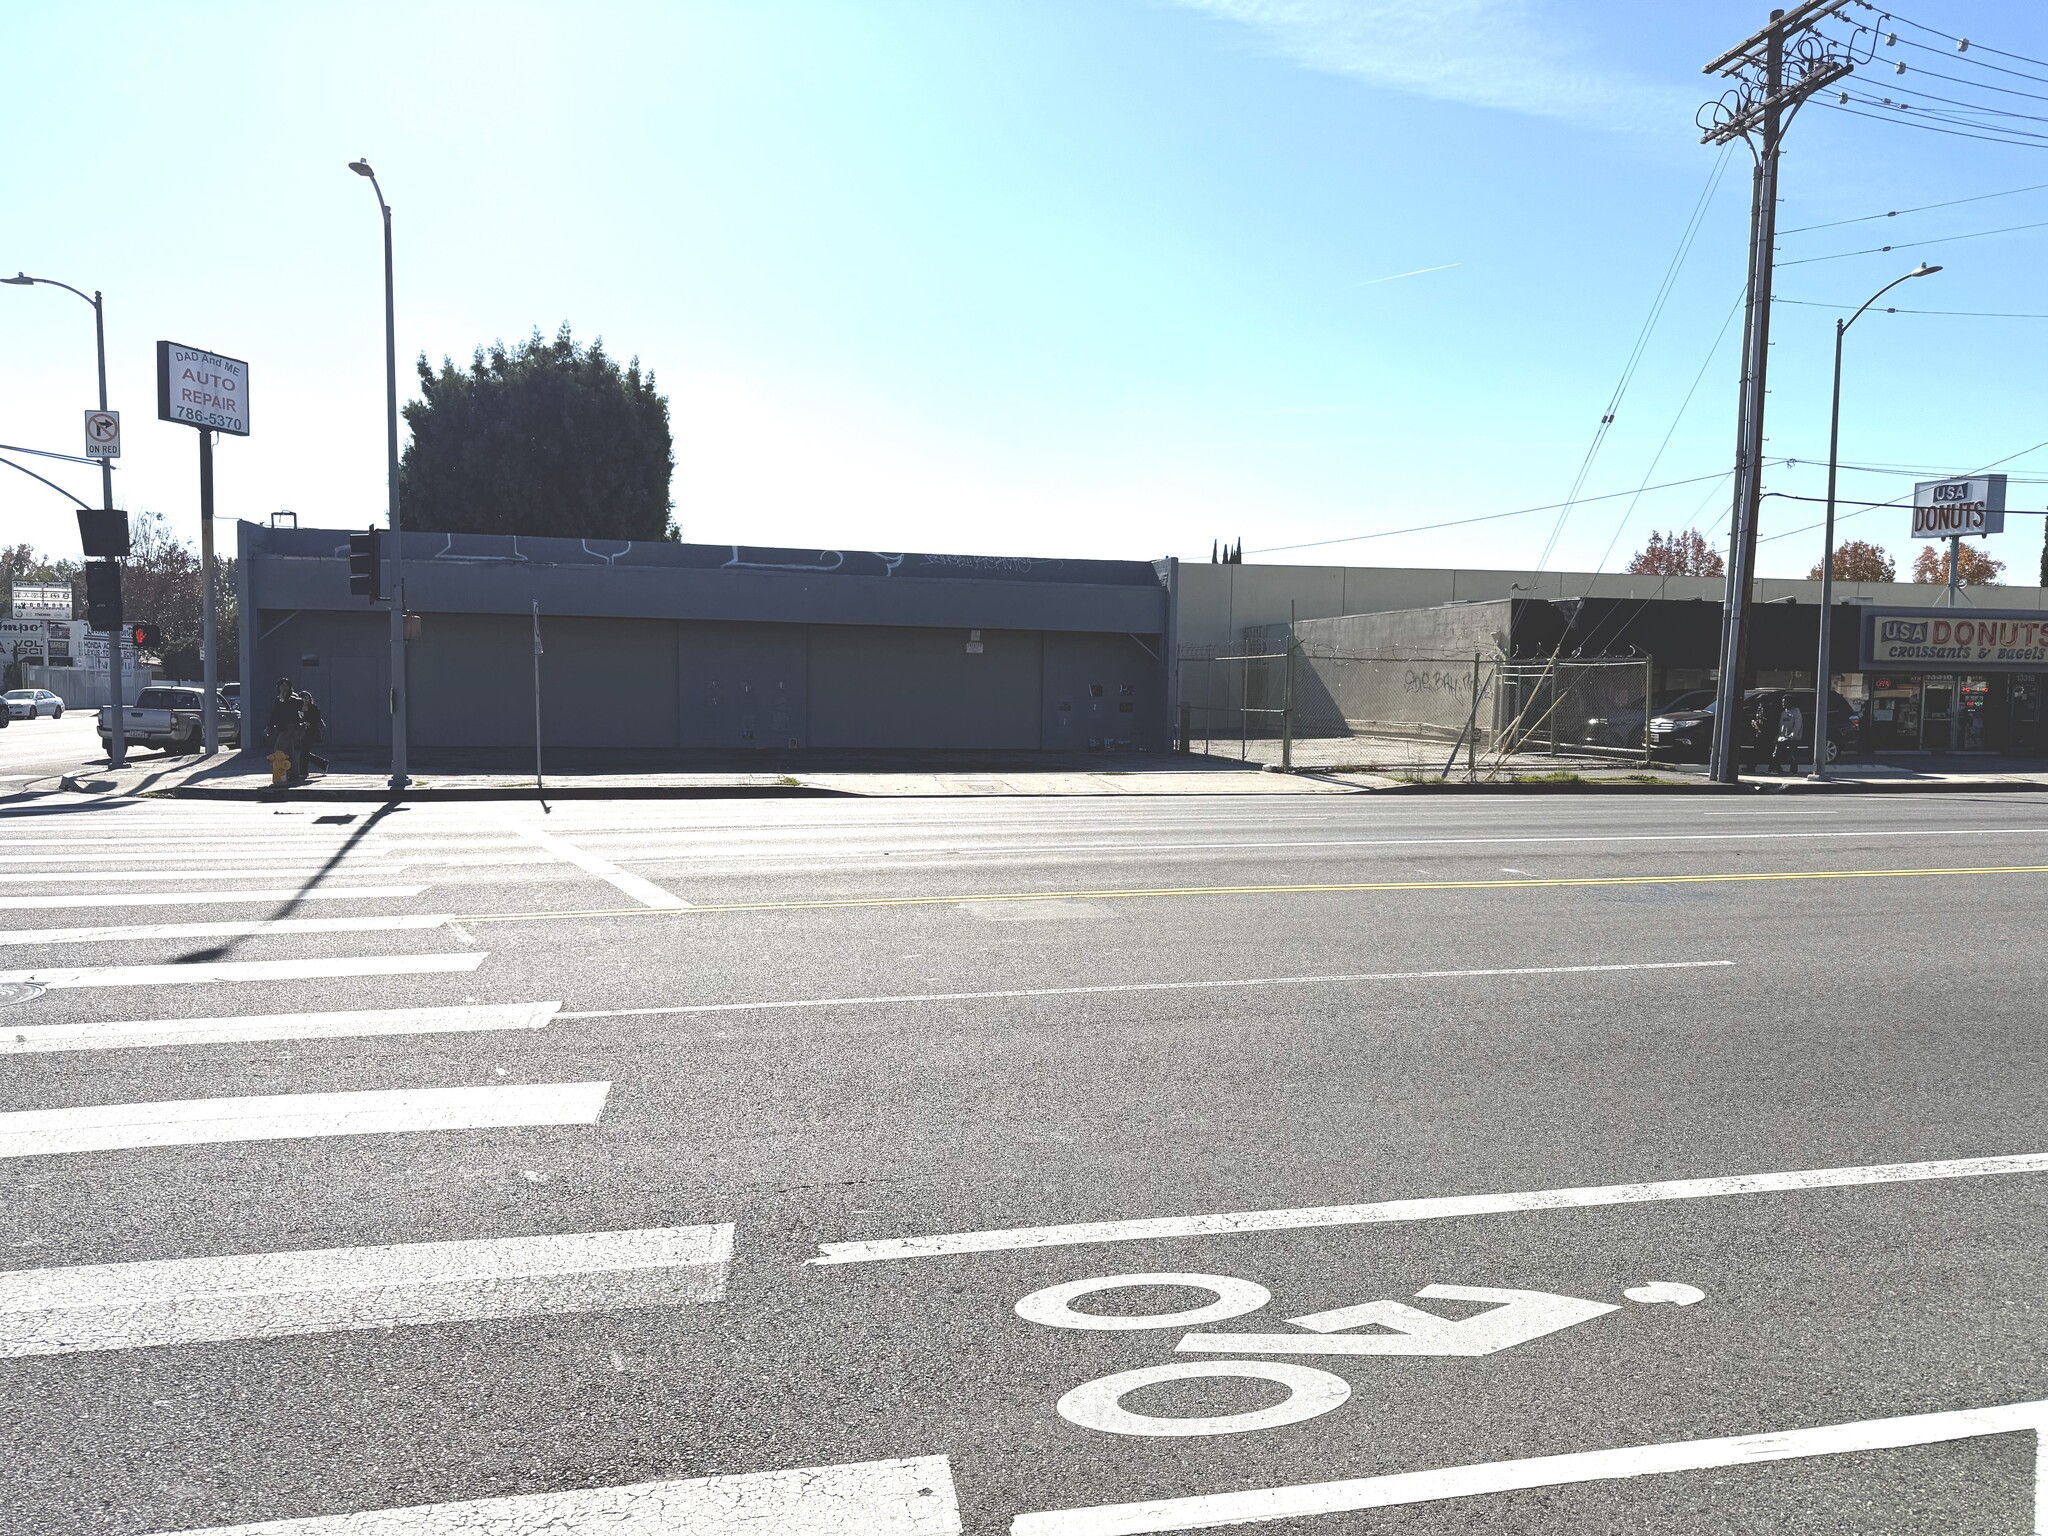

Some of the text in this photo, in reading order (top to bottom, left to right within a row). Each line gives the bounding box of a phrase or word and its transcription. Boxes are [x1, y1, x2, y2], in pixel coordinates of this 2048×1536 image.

[176, 352, 240, 377] DAD And ME
[182, 368, 236, 392] AUTO
[182, 388, 237, 413] REPAIR
[176, 405, 242, 431] 786-5370
[89, 445, 118, 455] ON RED
[1936, 485, 1965, 500] USA
[1914, 501, 1985, 532] DONUTS
[1885, 621, 1925, 640] USA
[84, 641, 101, 650] HONDA
[84, 649, 101, 658] LEXUS
